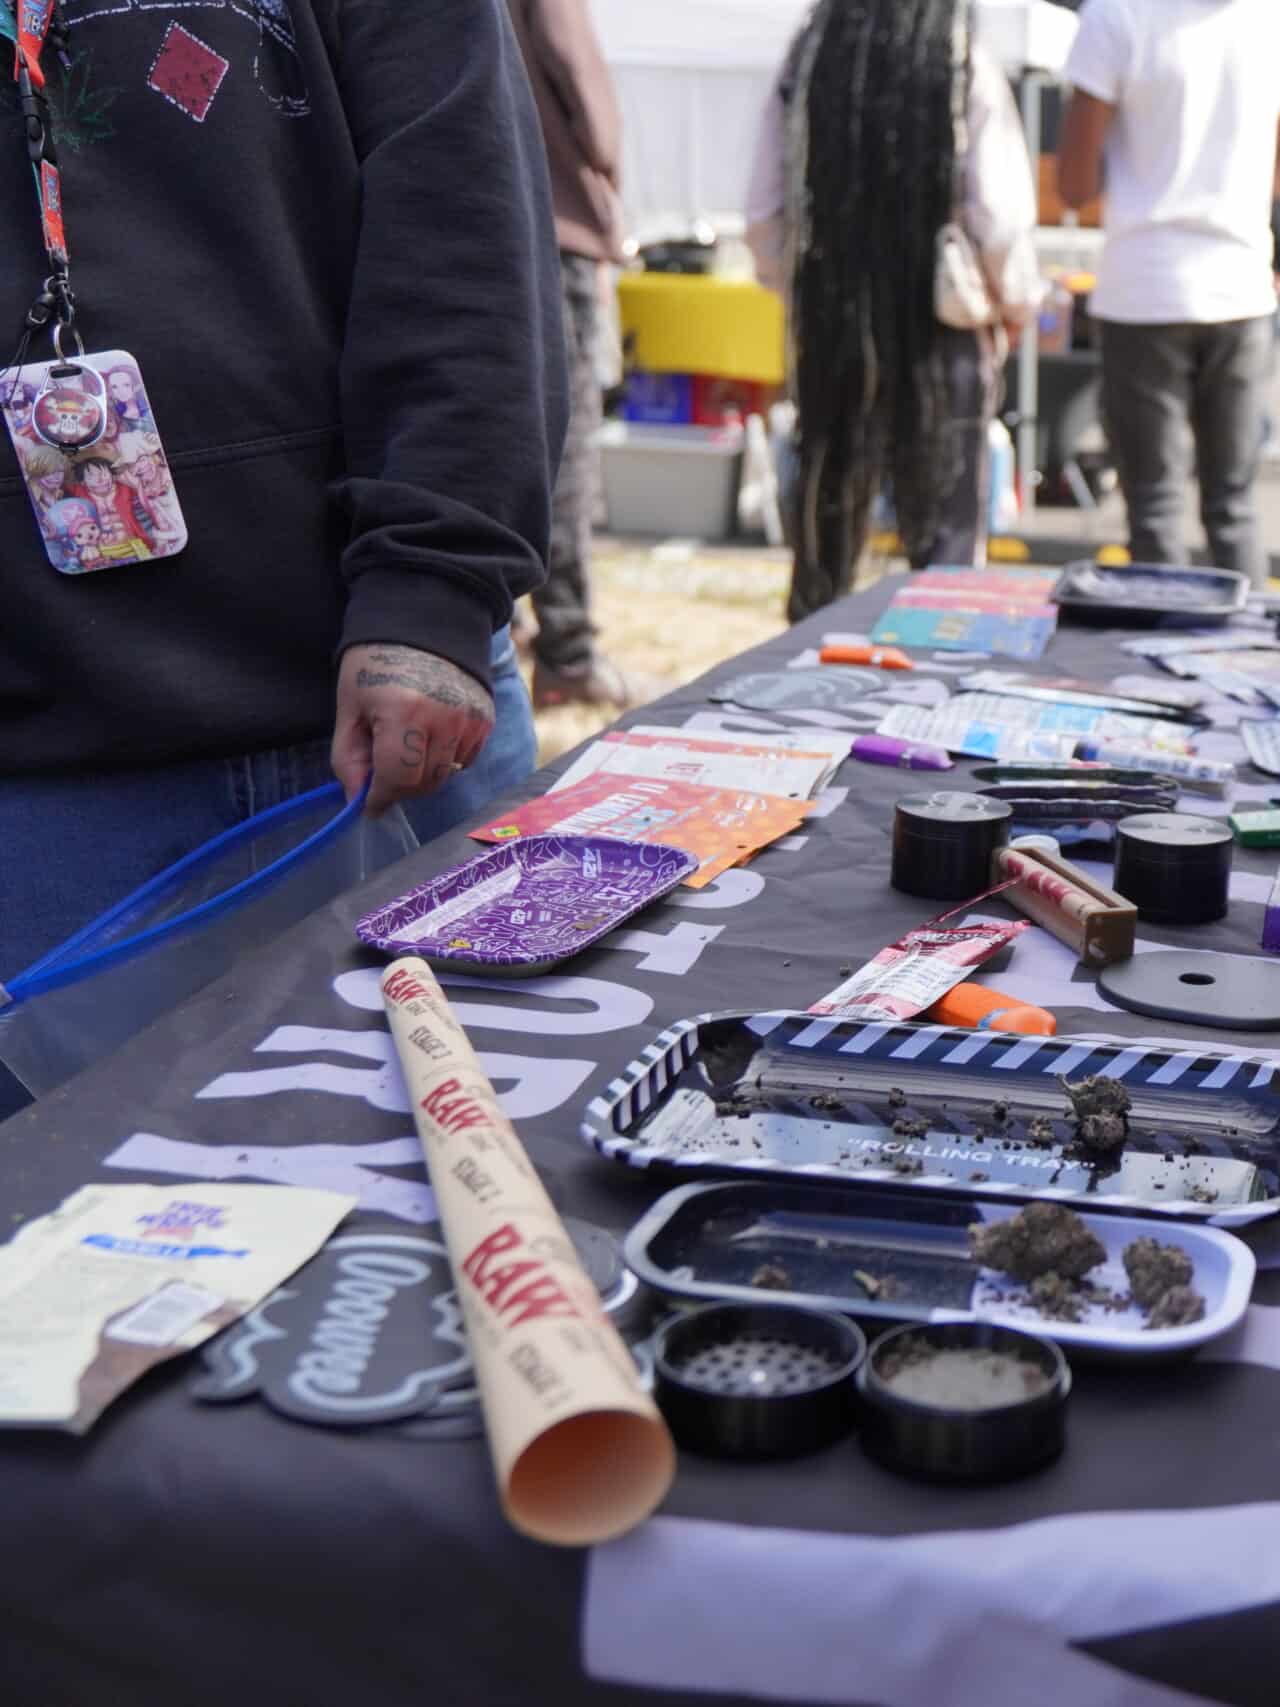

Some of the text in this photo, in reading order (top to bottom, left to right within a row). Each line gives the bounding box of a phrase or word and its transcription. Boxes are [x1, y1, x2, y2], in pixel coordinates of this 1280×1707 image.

[384, 968, 432, 1005] RAW
[421, 1078, 496, 1135] RAW
[462, 1221, 584, 1329] RAW
